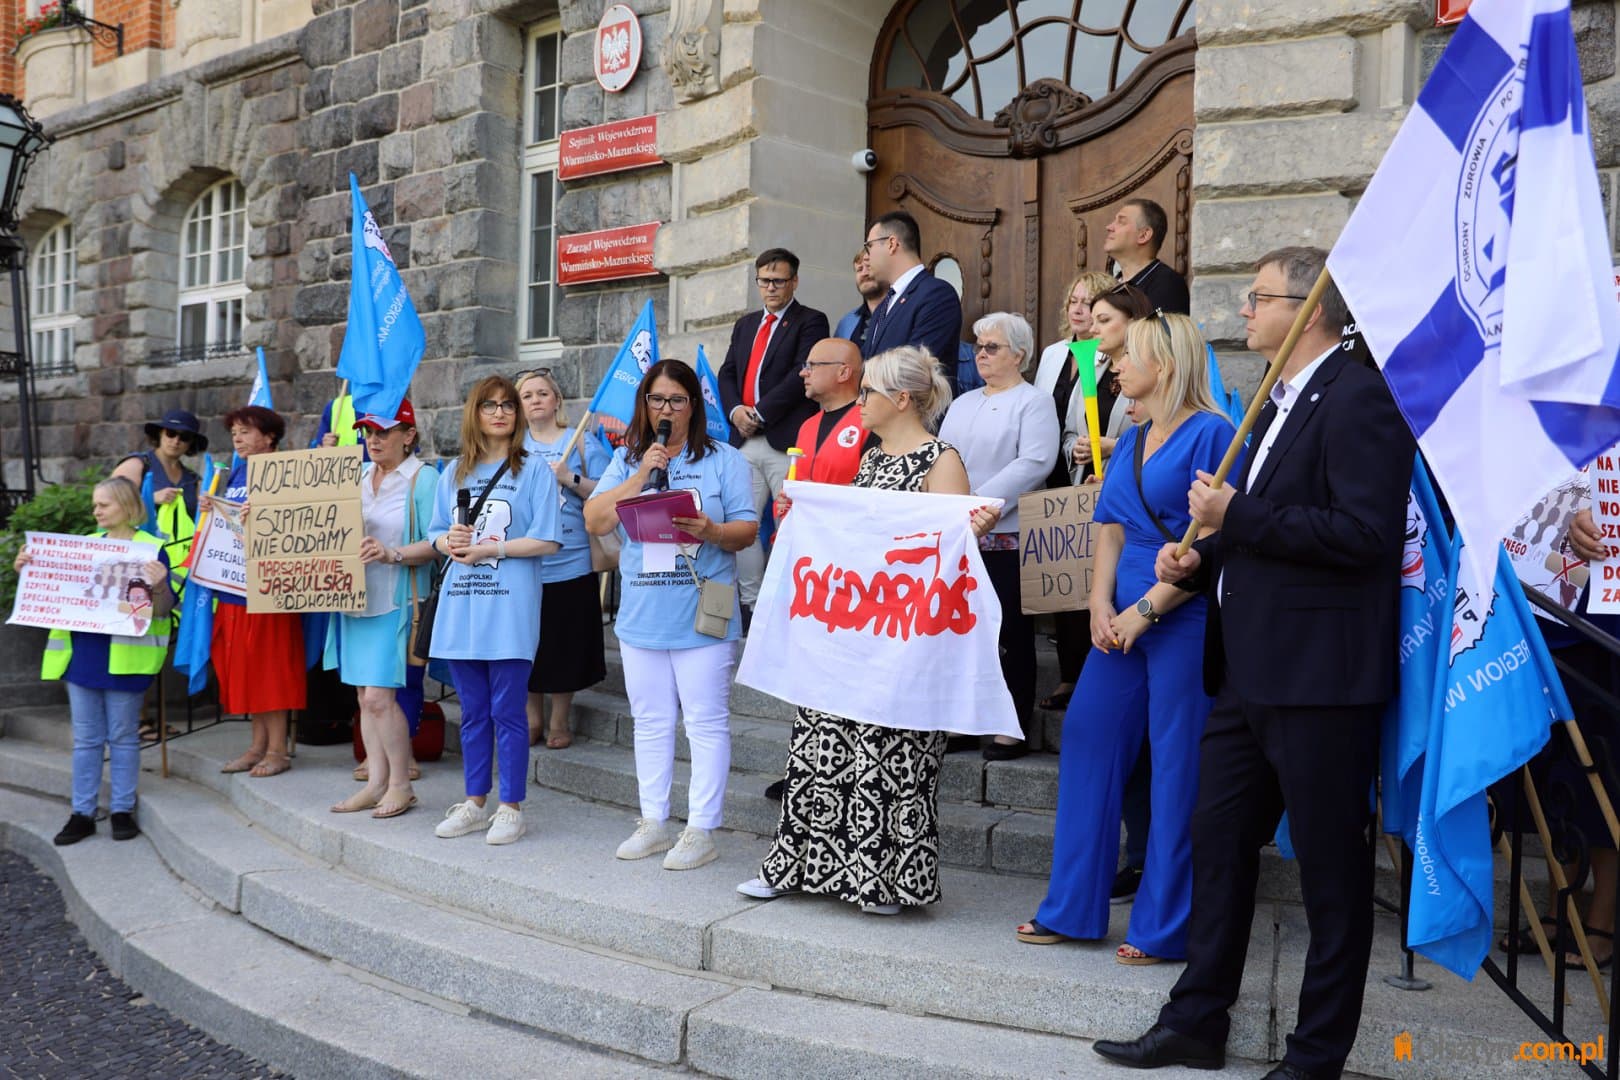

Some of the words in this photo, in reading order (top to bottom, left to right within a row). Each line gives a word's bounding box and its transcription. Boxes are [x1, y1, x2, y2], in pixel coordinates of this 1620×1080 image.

[568, 134, 595, 149] Sejmik
[598, 125, 653, 143] Województwa
[1464, 138, 1487, 199] ZDROWIA
[566, 241, 592, 254] Zarząd
[594, 235, 647, 251] Województwa
[1462, 221, 1472, 282] OCHRONY
[250, 454, 362, 494] WOJEWÓDZKIEGO
[1597, 455, 1613, 471] NA
[1044, 495, 1069, 518] DY
[256, 504, 338, 537] SZPITALA
[59, 539, 82, 548] ZGODY
[252, 538, 278, 558] NIE
[282, 527, 353, 554] ODDAMY
[1022, 522, 1094, 567] ANDRZE
[231, 571, 247, 583] OLS
[1042, 572, 1073, 597] DO
